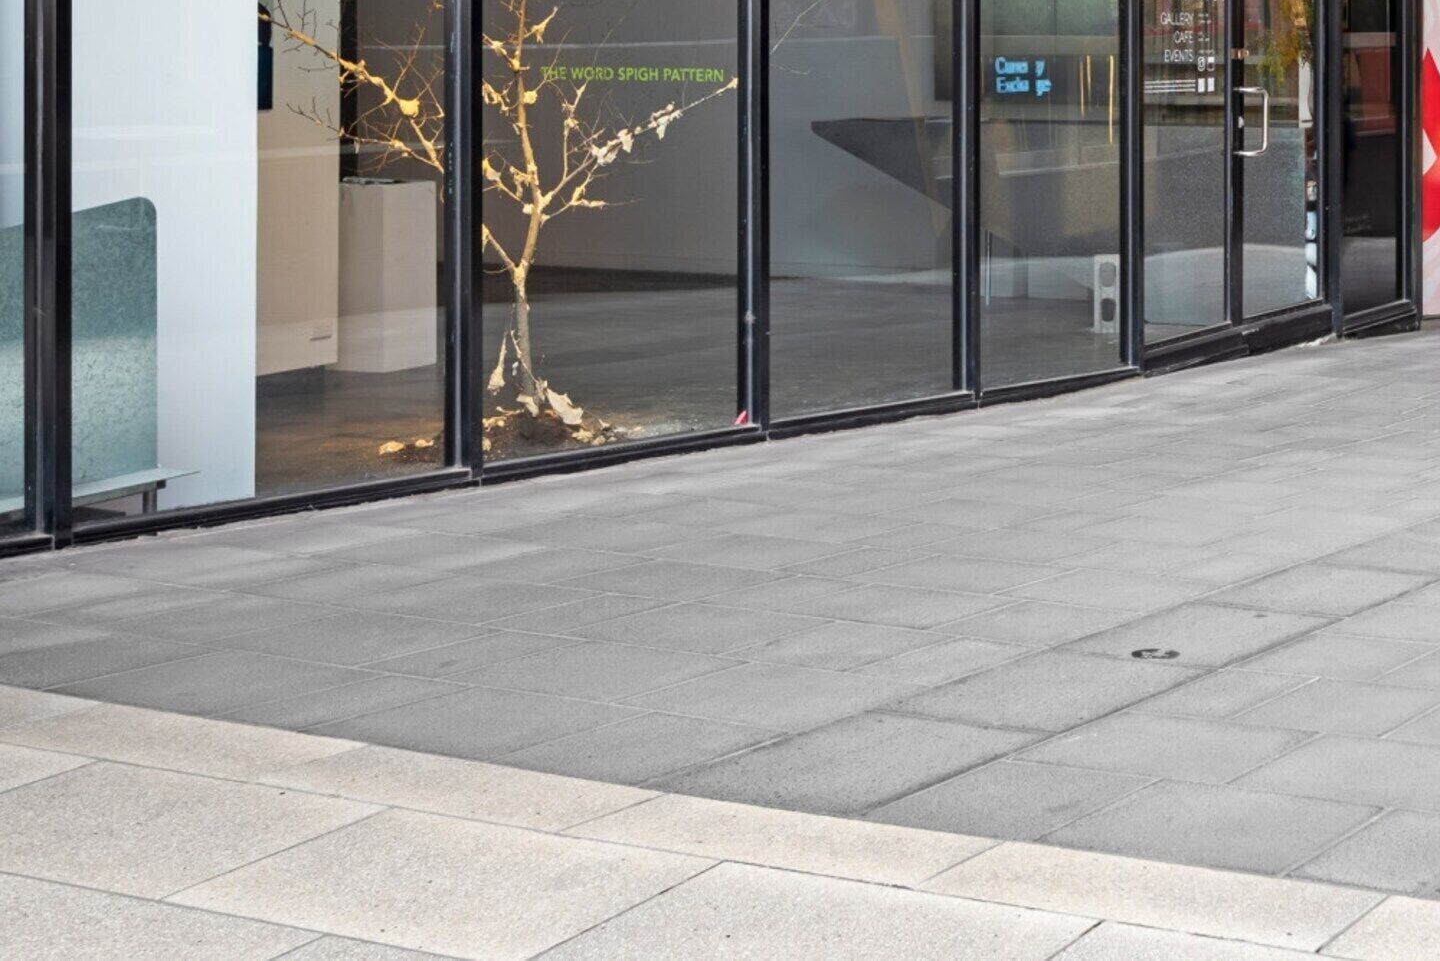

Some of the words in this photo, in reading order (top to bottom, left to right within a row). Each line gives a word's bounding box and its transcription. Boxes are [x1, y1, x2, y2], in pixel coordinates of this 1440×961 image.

[1160, 12, 1194, 26] GALLERY
[1164, 49, 1194, 62] EVENTS
[541, 66, 567, 81] THE
[571, 66, 615, 81] WORD
[618, 67, 660, 82] SPIGH
[663, 67, 725, 82] PATTERN
